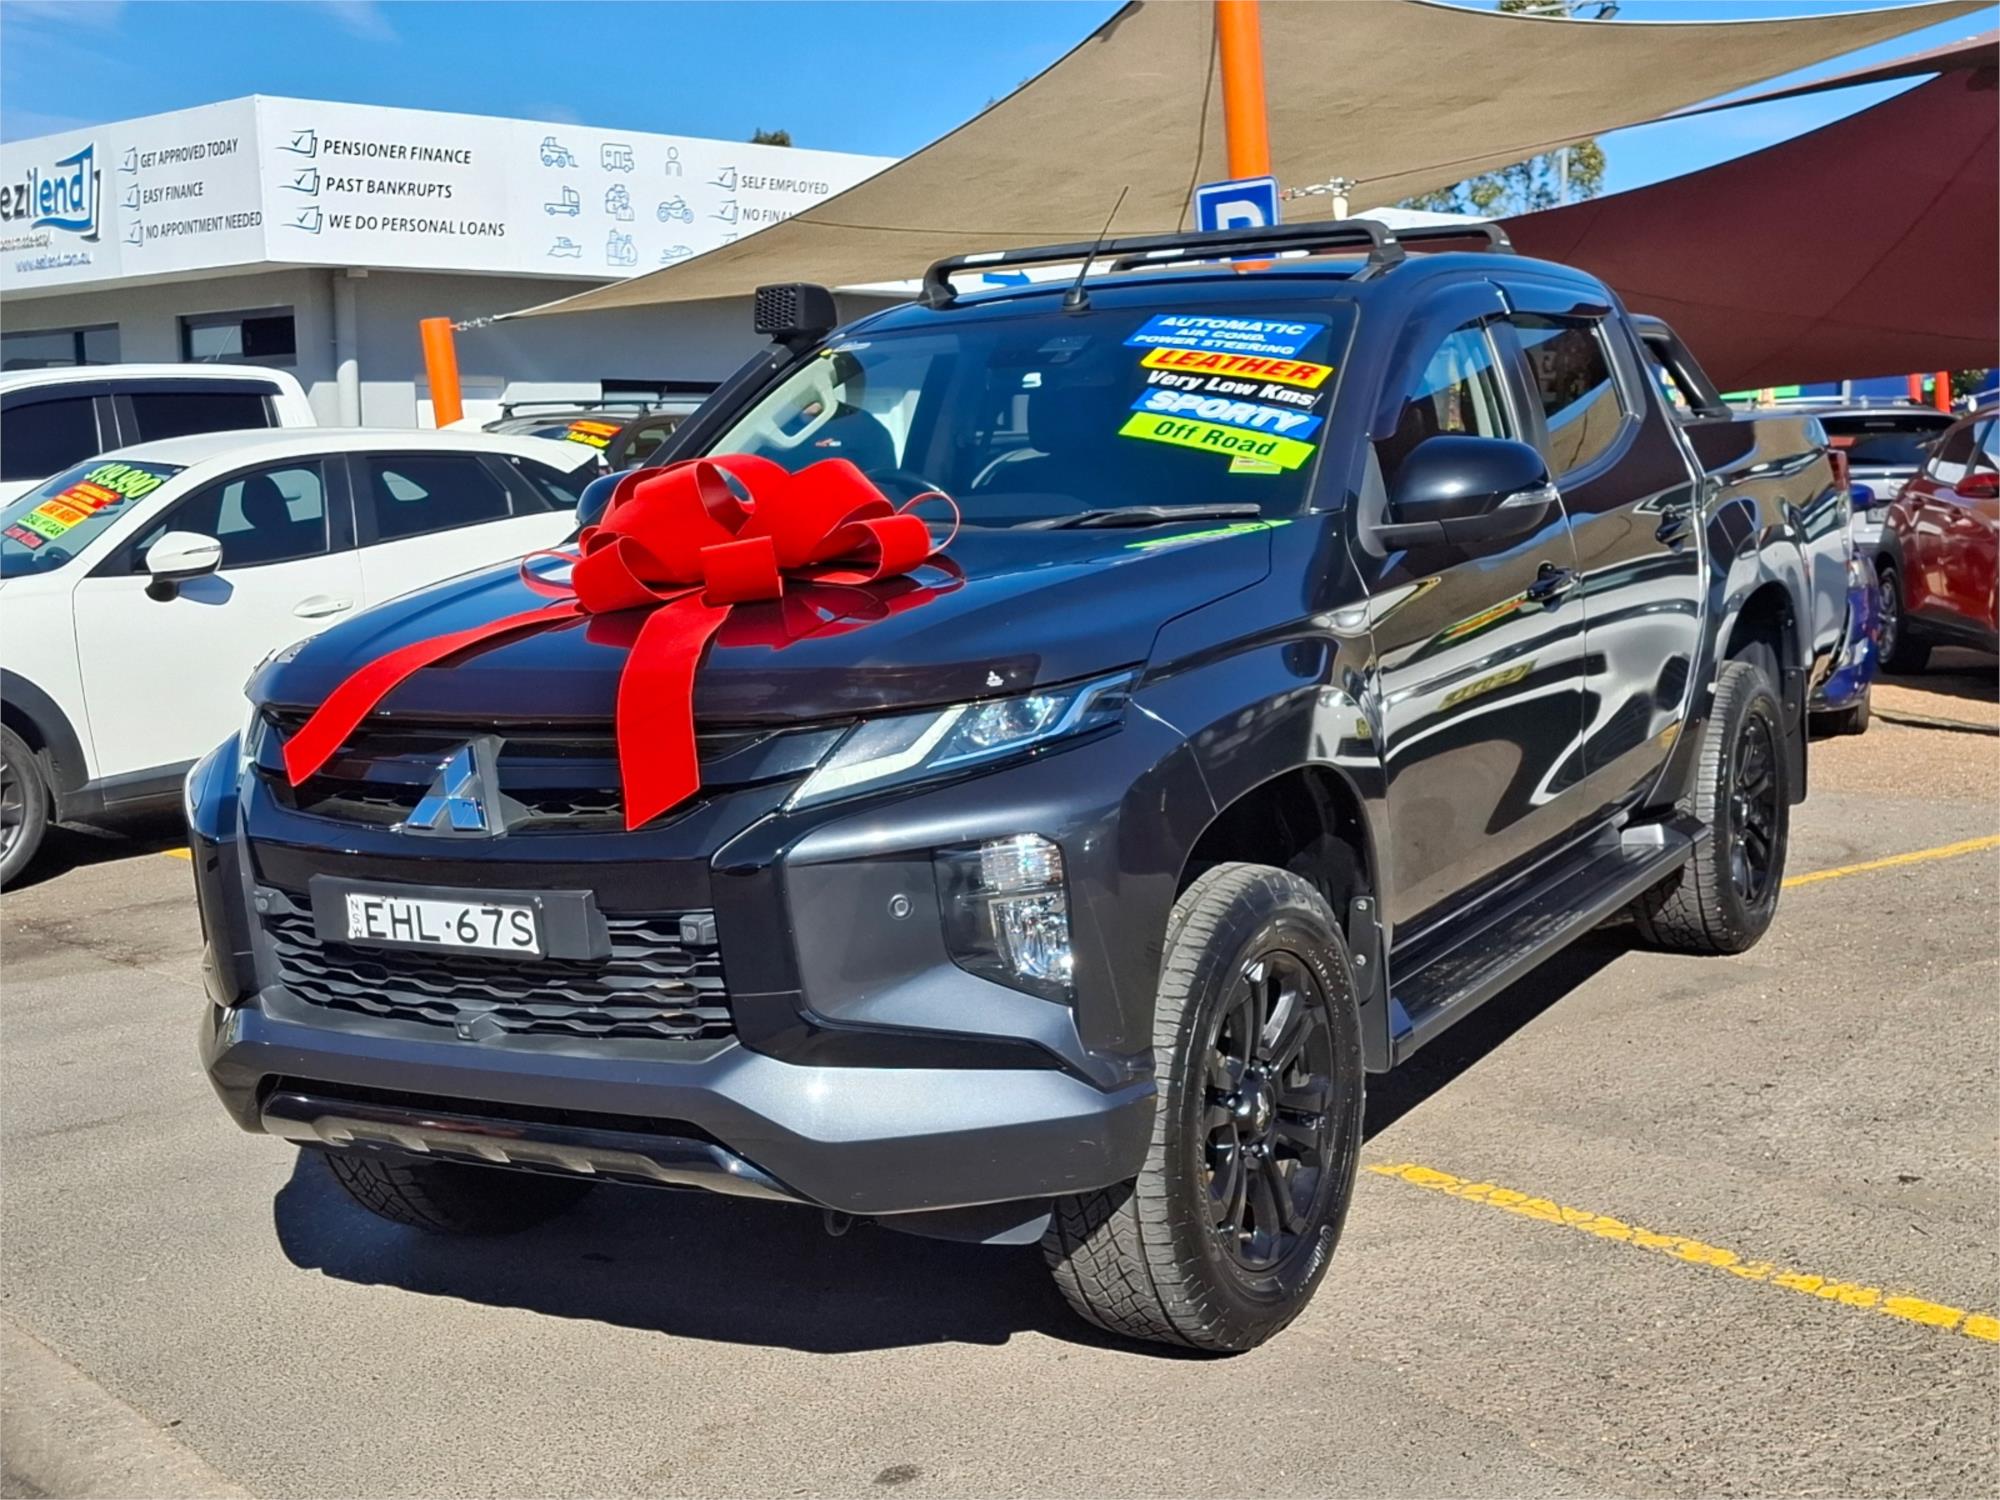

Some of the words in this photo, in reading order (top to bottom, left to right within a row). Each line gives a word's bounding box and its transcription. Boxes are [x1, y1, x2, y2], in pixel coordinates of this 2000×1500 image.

[140, 151, 157, 169] GET
[159, 144, 206, 166] APPROVED
[207, 137, 239, 157] TODAY
[323, 139, 408, 160] PENSIONER
[410, 146, 473, 165] FINANCE
[143, 186, 165, 205] EASY
[166, 181, 204, 201] FINANCE
[326, 177, 364, 193] PAST
[367, 180, 453, 199] BANKRUPTS
[741, 175, 767, 190] SELF
[769, 178, 829, 195] EMPLOYED
[146, 223, 159, 239] NO
[161, 216, 224, 238] APPOINTMENT
[225, 211, 263, 230] NEEDED
[329, 213, 351, 230] WE
[355, 215, 378, 231] DO
[382, 217, 456, 235] PERSONAL
[459, 220, 505, 238] LOANS
[742, 208, 760, 222] NO
[1158, 316, 1306, 335] AUTOMATIC
[1175, 328, 1209, 337] AIR
[1211, 329, 1267, 342] COND.
[1133, 335, 1196, 346] POWER
[1200, 338, 1296, 355] STEERING
[1154, 349, 1320, 380] LEATHER
[1147, 370, 1203, 391] Very
[1204, 376, 1258, 395] Low
[1145, 390, 1310, 432] SPORTY
[1153, 420, 1200, 441] Off
[1200, 428, 1279, 456] Road
